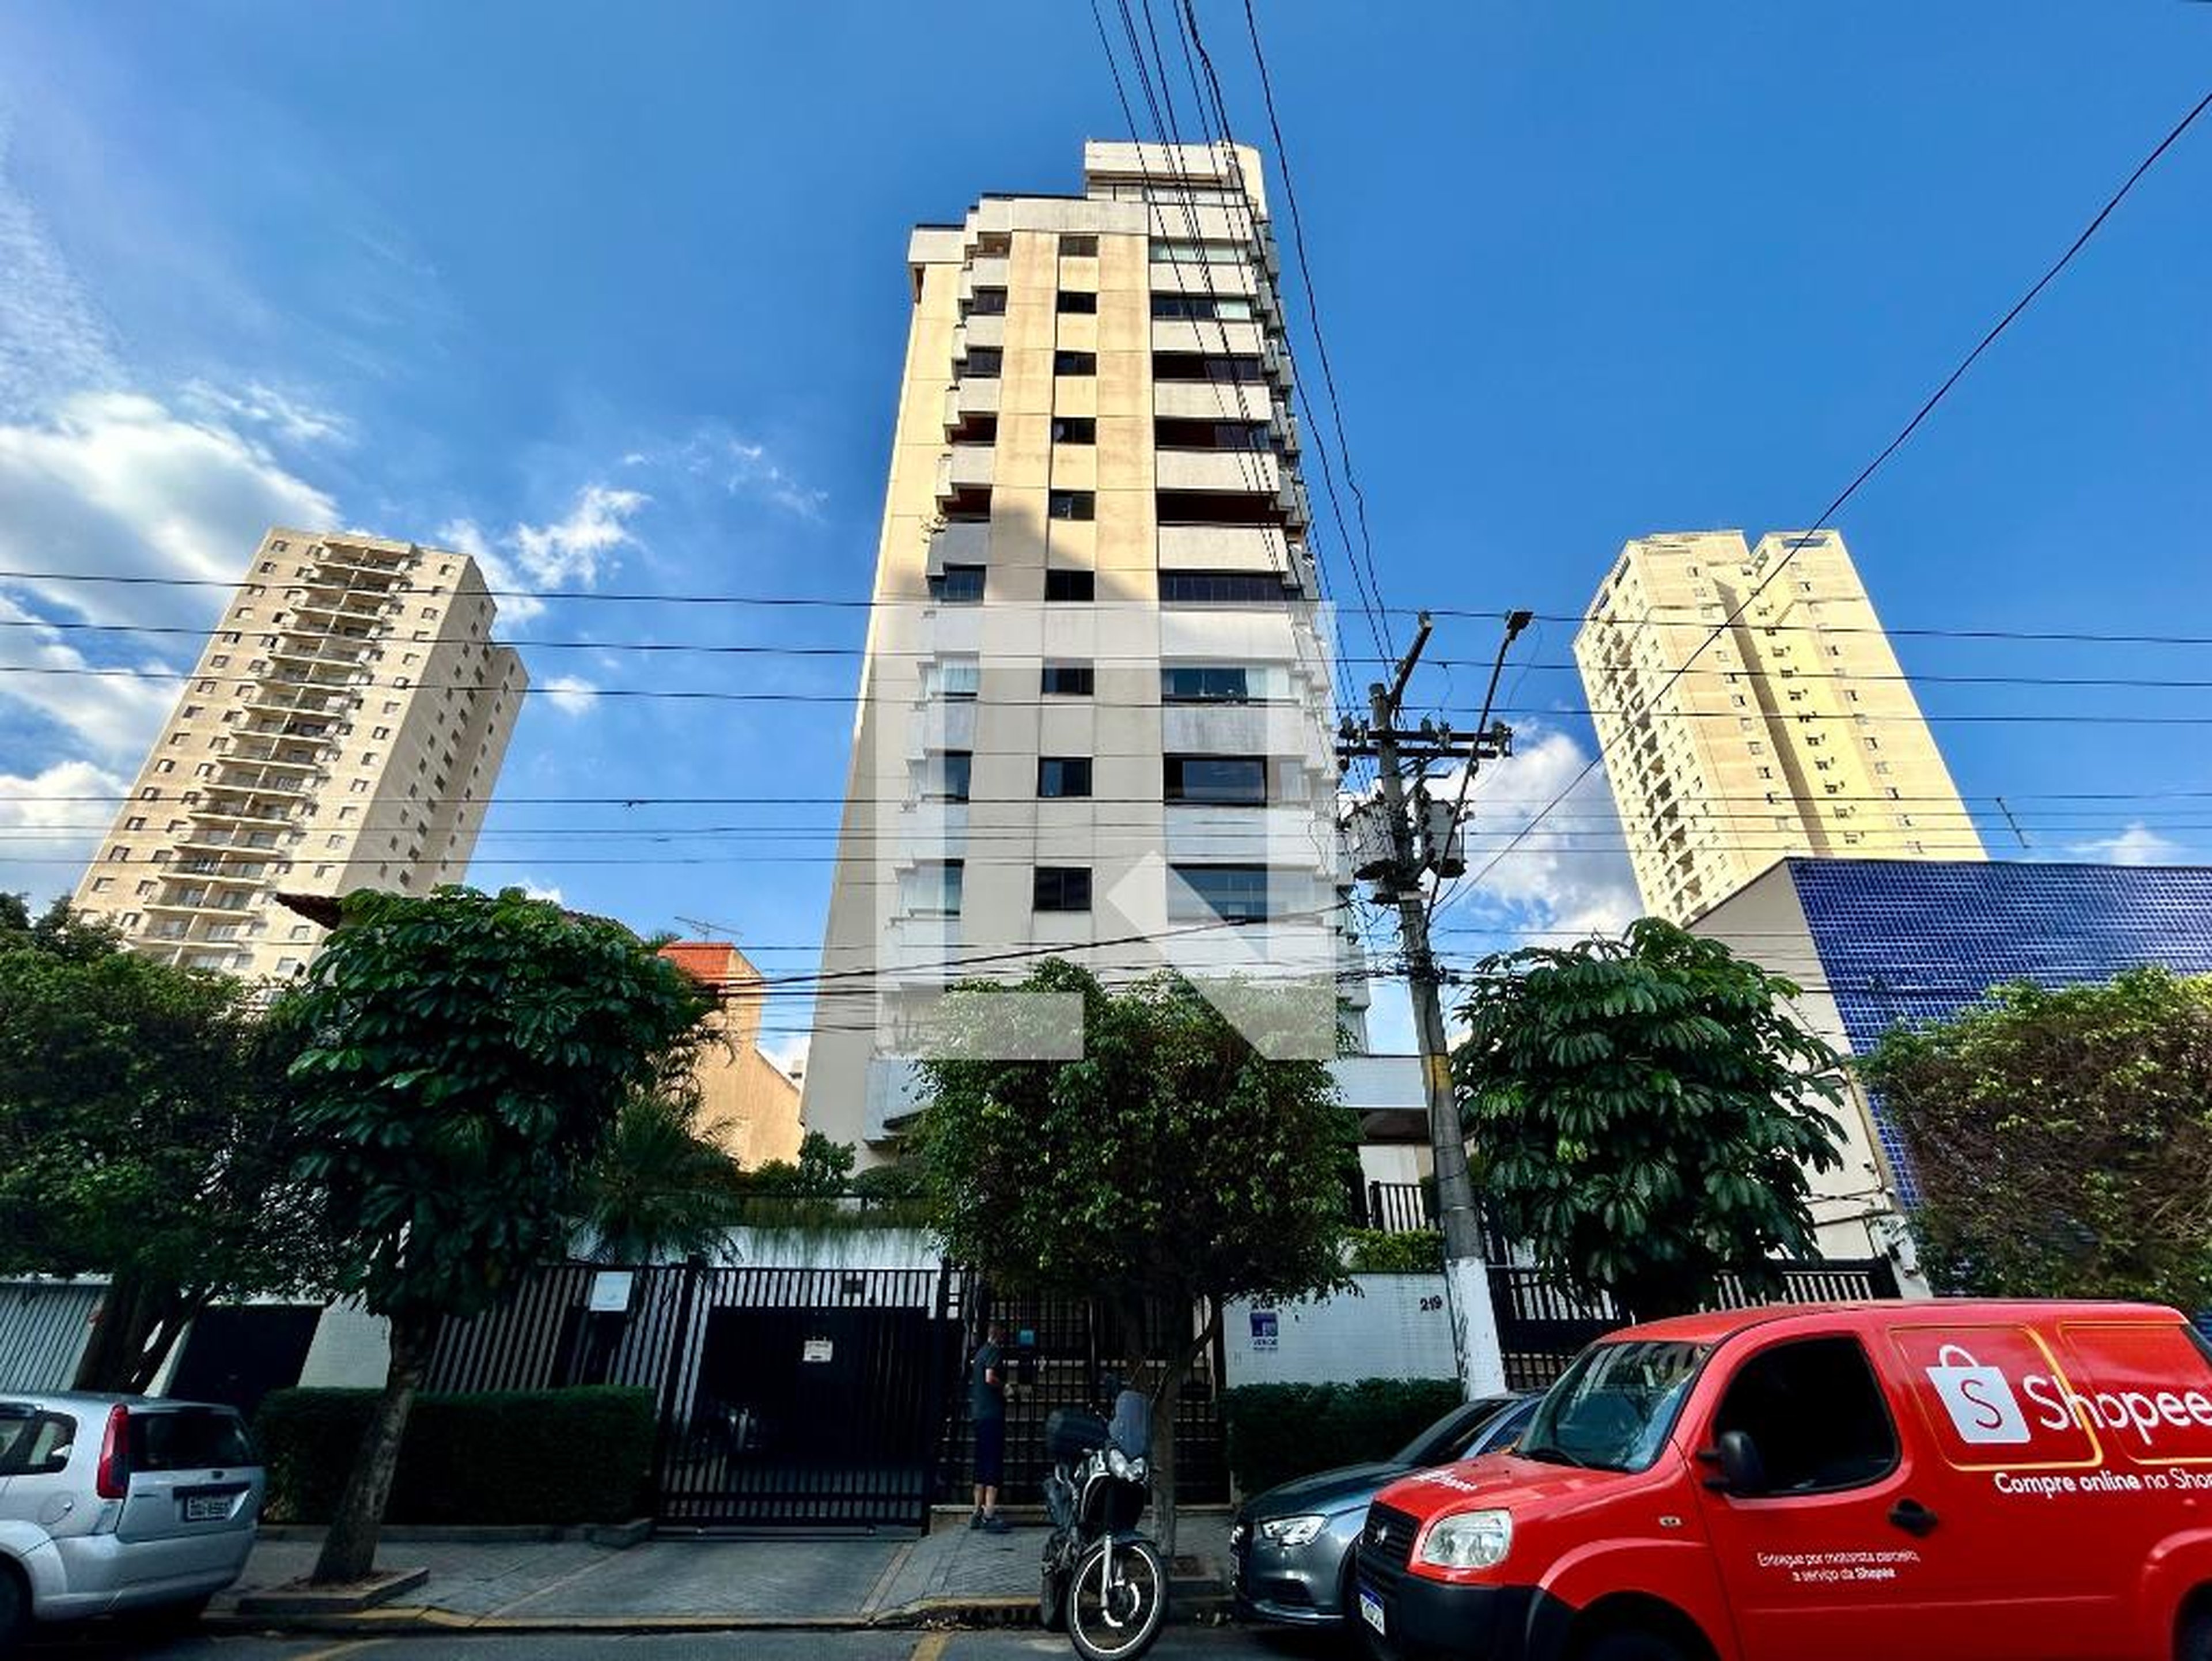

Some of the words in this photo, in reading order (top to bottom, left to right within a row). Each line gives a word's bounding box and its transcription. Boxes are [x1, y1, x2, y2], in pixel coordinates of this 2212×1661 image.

[1419, 1295, 1442, 1311] 219
[2023, 1375, 2212, 1445] Shopee
[1994, 1472, 2076, 1499] Compre
[2079, 1470, 2141, 1491] online
[2143, 1474, 2169, 1489] no
